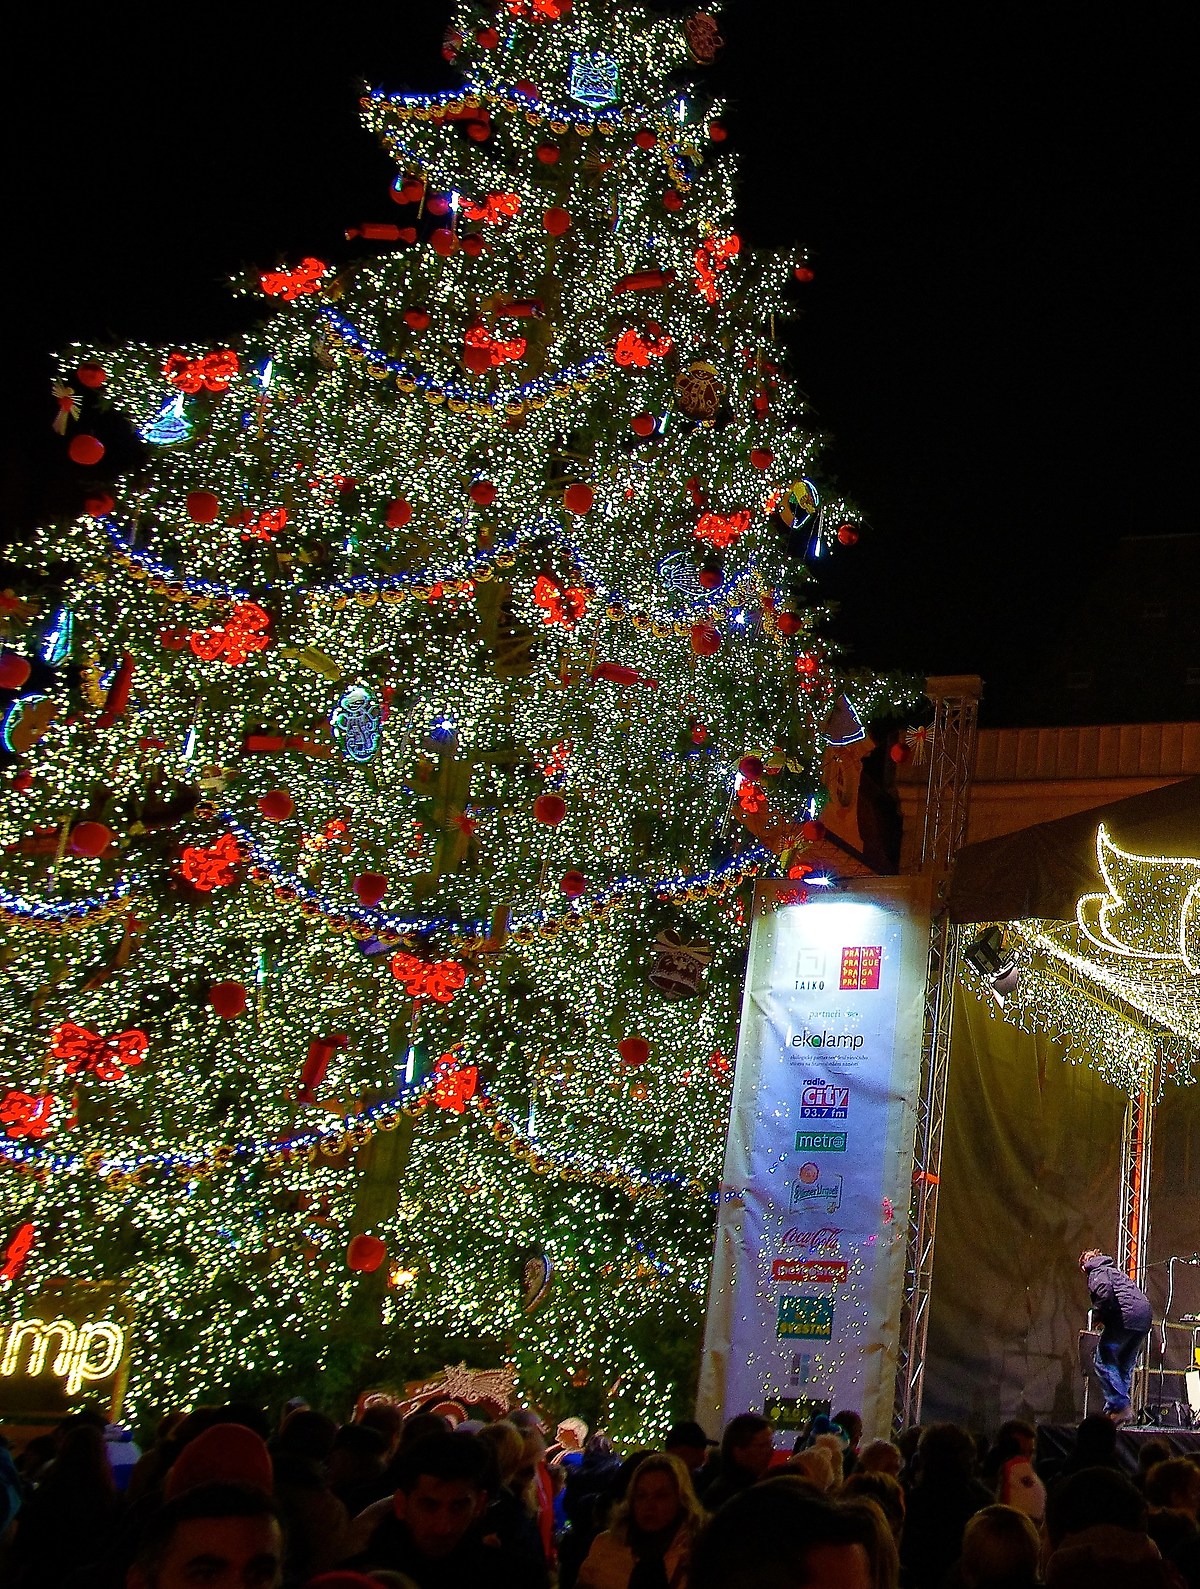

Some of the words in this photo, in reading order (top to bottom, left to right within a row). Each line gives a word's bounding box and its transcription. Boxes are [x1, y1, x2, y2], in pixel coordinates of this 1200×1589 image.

[845, 949, 859, 957] PRA
[862, 949, 875, 957] HA
[844, 959, 858, 967] PRA
[862, 959, 879, 967] GUE
[794, 980, 825, 990] TAIKO
[842, 978, 857, 986] PRA
[792, 1030, 864, 1050] ekolamp
[804, 1108, 828, 1117] 93.7
[831, 1108, 845, 1117] fm
[0, 1319, 125, 1396] mp
